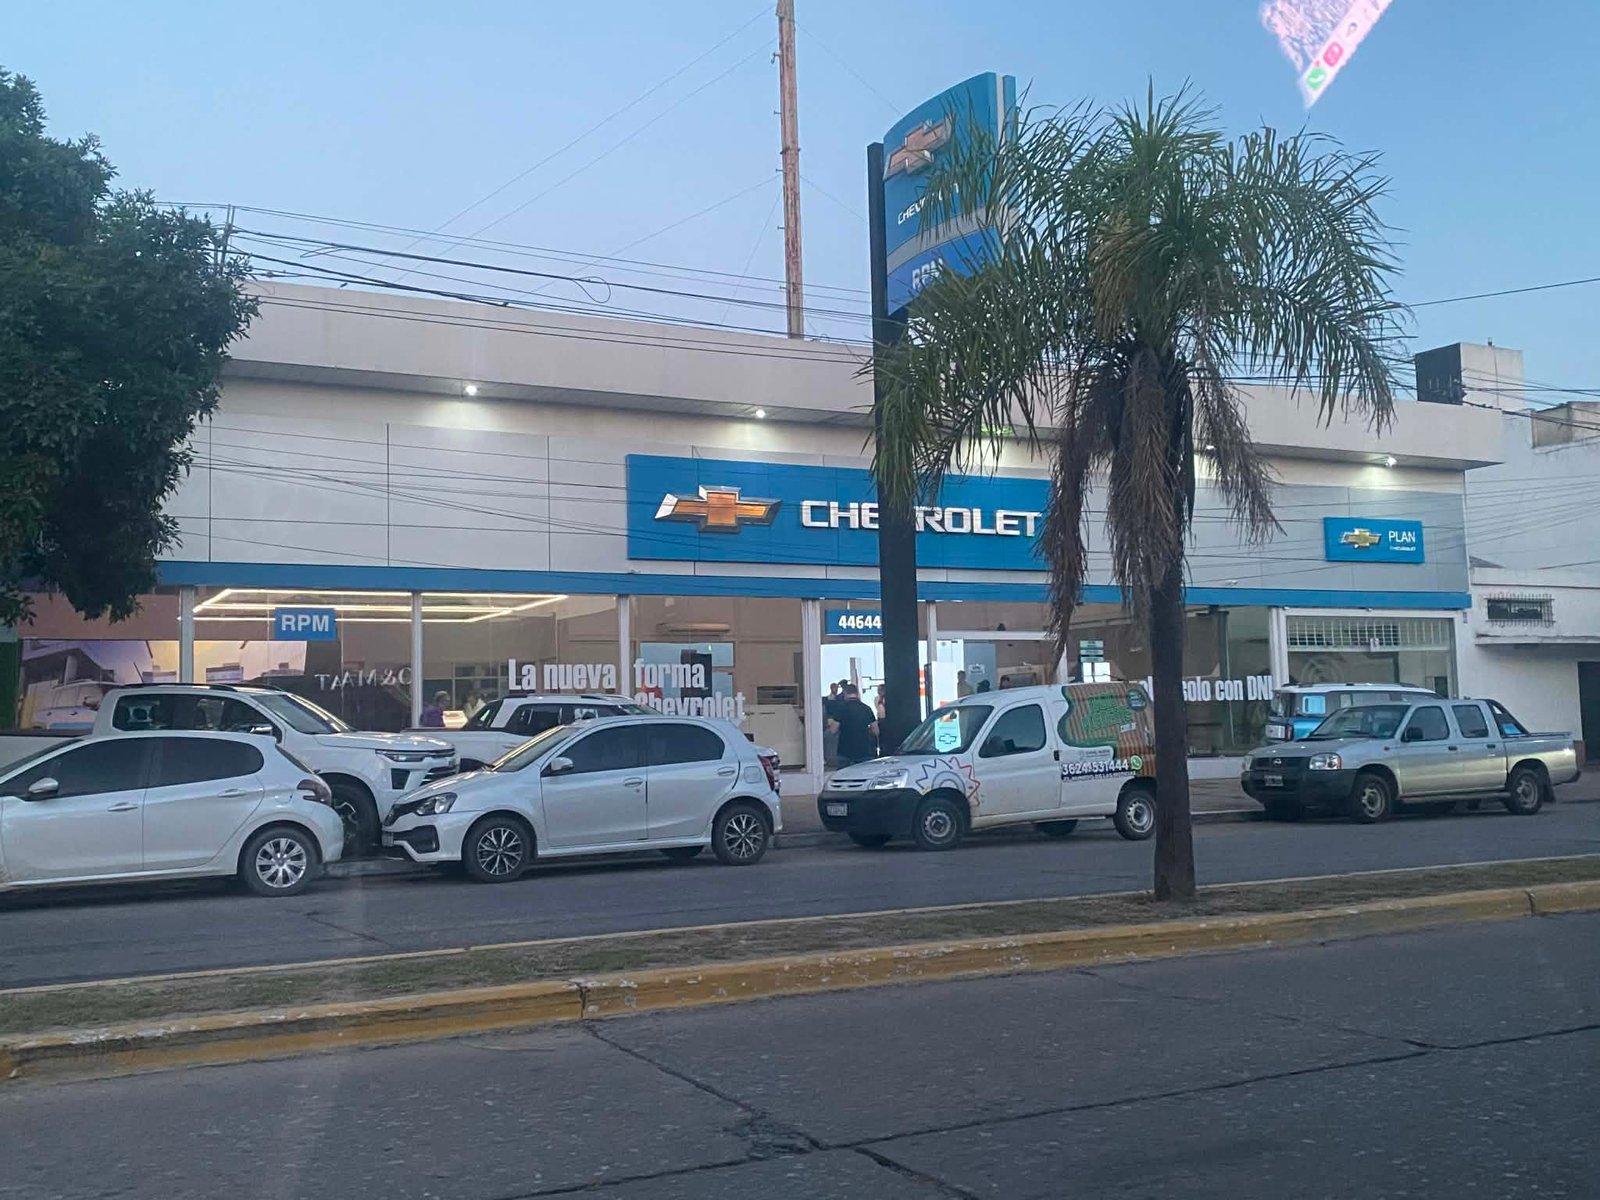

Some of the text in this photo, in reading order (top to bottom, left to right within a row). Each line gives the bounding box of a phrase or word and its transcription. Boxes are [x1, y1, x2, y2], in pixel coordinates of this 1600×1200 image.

[802, 499, 1042, 537] CHEROLET
[1388, 530, 1416, 543] PLAN
[281, 614, 329, 632] RPM
[508, 658, 706, 690] La nueva forma
[1215, 679, 1244, 701] con
[1247, 675, 1274, 701] DNI
